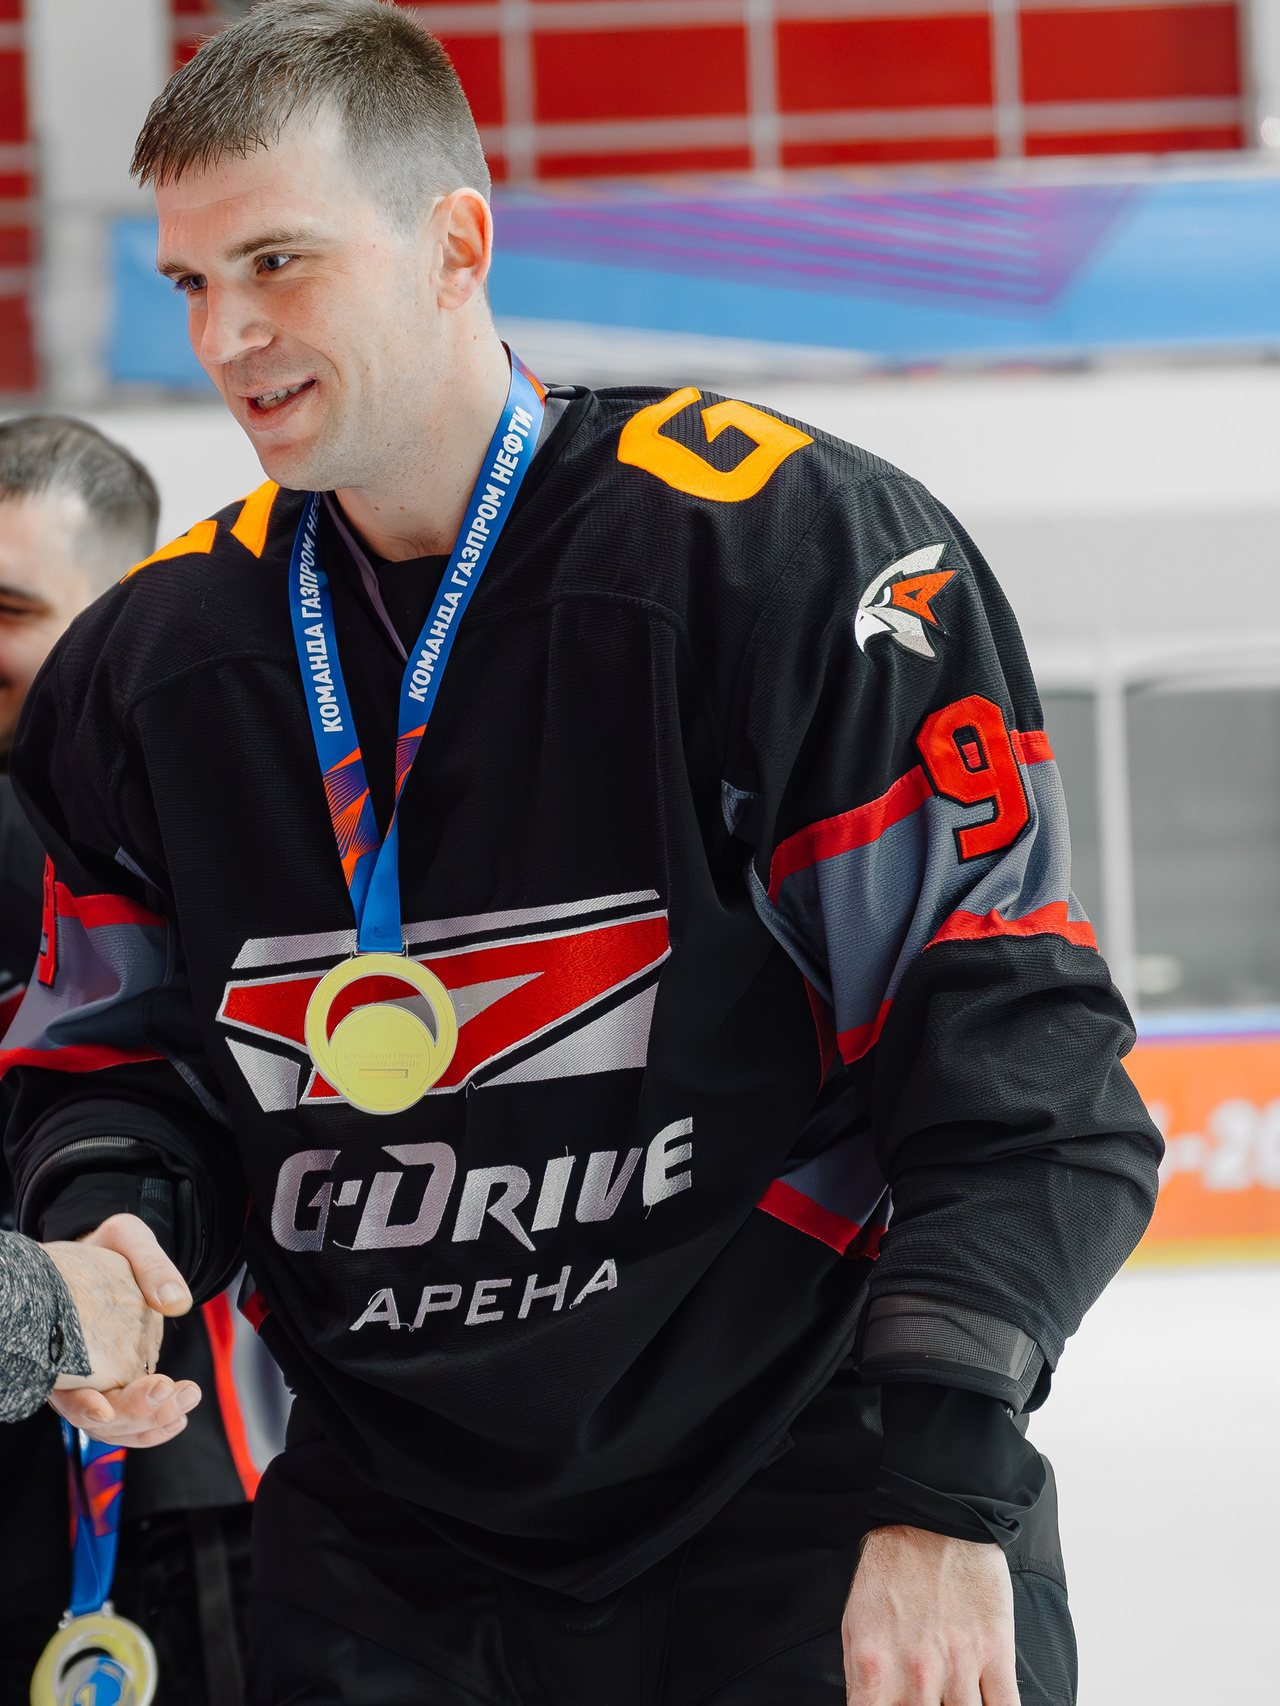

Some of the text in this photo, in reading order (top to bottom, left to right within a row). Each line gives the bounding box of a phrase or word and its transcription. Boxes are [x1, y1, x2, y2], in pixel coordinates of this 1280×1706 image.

[300, 532, 323, 619] ГАЗПРОМ
[408, 405, 533, 702] КОМАНДА ГАЗПРОМ НЕФТИ
[304, 623, 344, 732] КОМАНДА
[916, 694, 1029, 864] 9
[349, 1258, 619, 1332] АРЕНА
